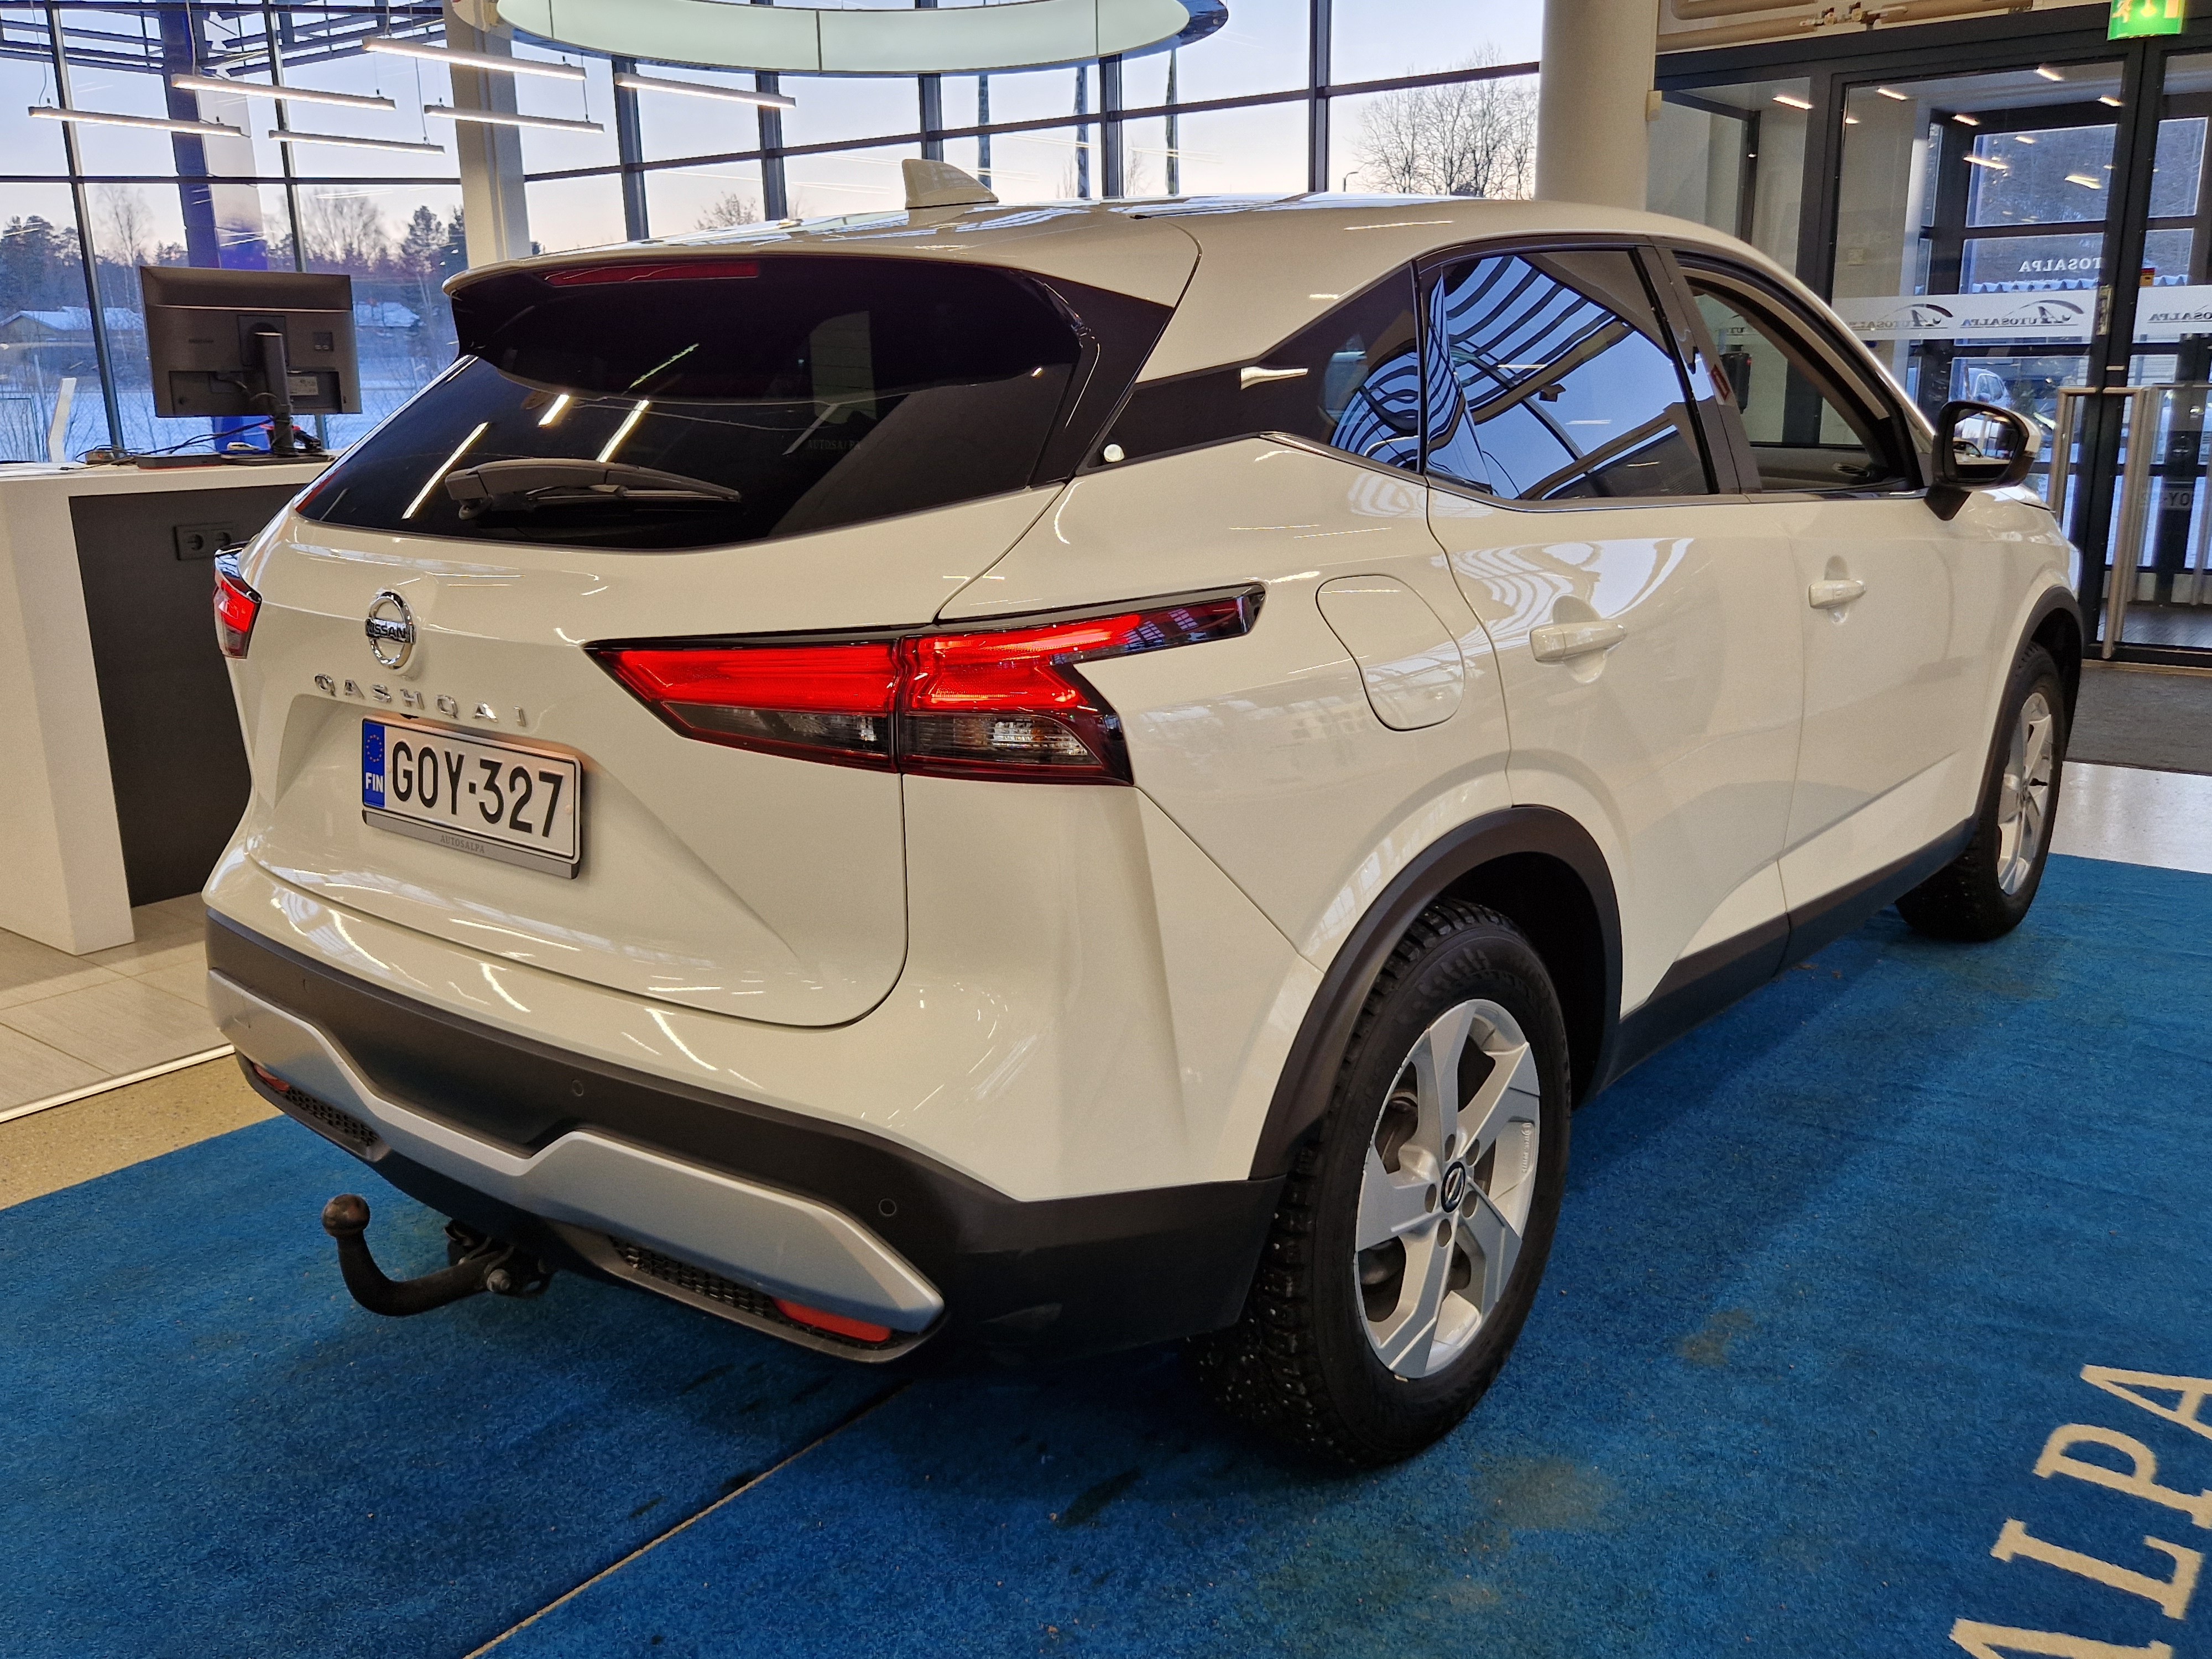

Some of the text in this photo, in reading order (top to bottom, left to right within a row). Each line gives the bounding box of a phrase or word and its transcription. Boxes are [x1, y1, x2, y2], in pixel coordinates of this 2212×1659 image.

[367, 622, 407, 640] NISSAN
[314, 672, 528, 727] QASHQAI
[365, 772, 384, 793] FIN
[392, 740, 564, 838] GOY-327
[440, 834, 485, 853] AUTOSALPA
